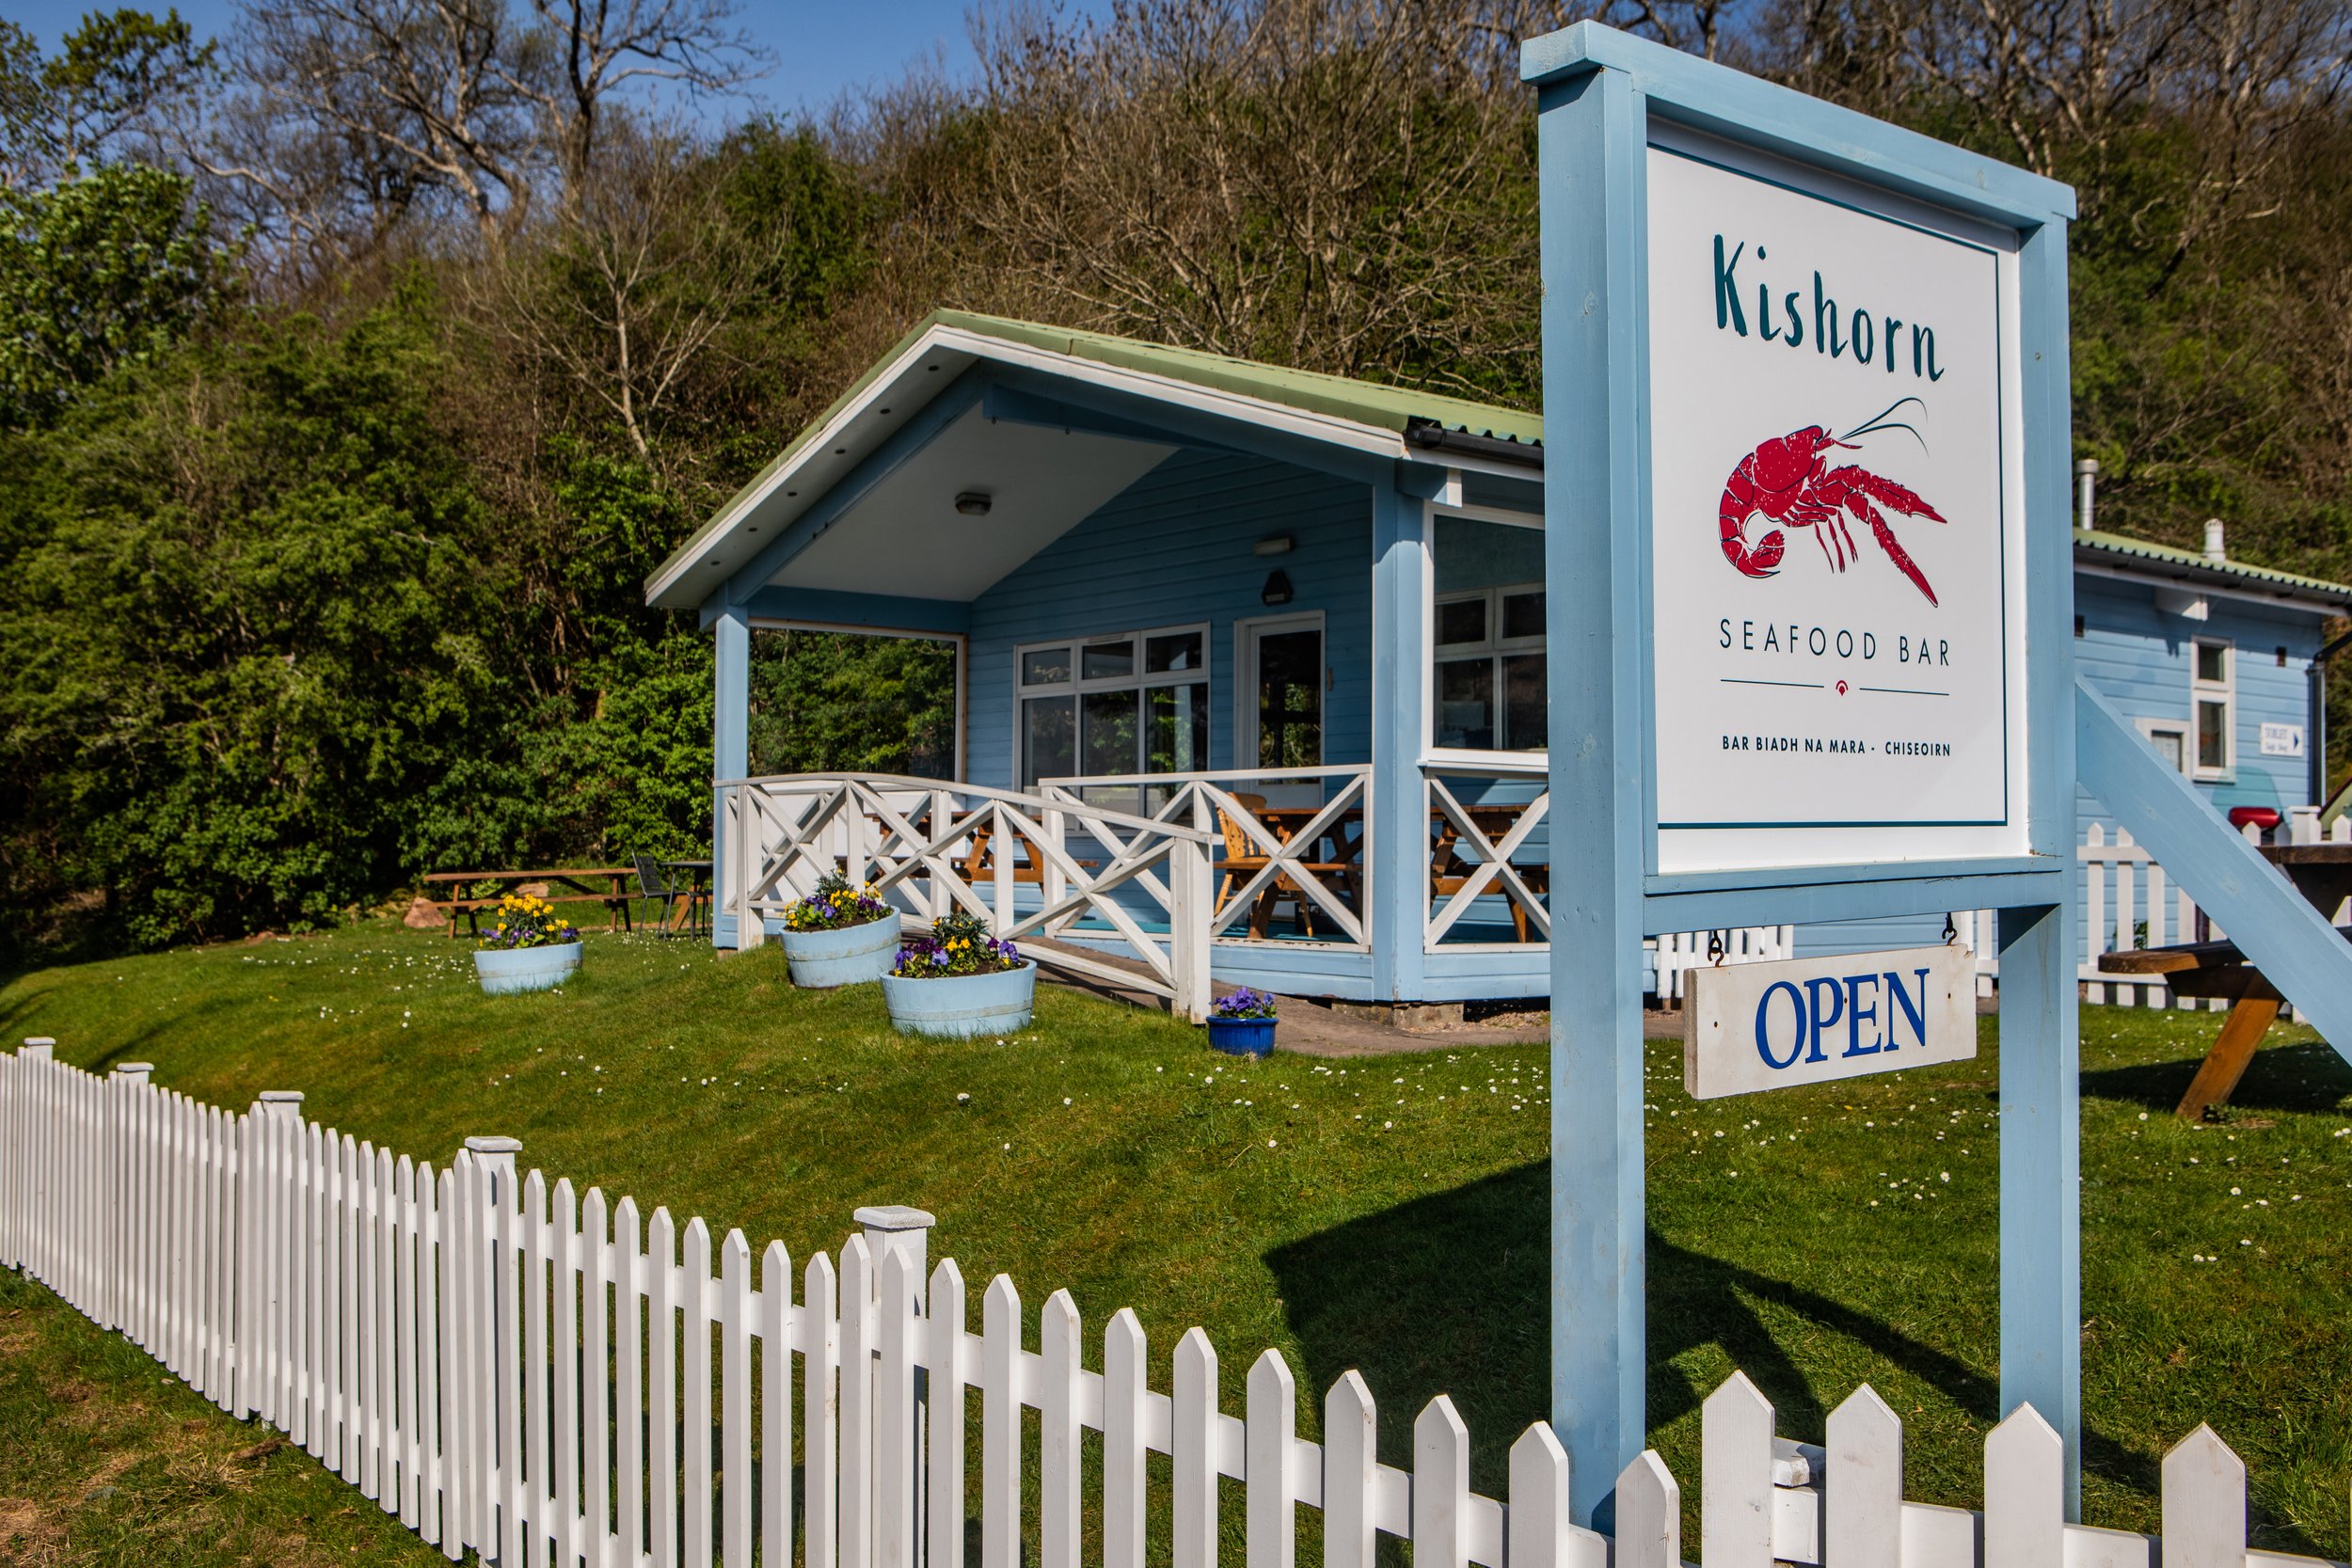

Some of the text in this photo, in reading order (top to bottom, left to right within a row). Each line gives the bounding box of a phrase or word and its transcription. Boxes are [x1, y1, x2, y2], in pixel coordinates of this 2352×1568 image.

[1713, 233, 1945, 383] Kishorn
[1720, 618, 1949, 666] SEAFOOD BAR
[1723, 736, 1749, 751] BAR
[1756, 736, 1798, 752] BIADH
[1804, 738, 1823, 752] NA
[1829, 739, 1866, 753] MARA
[1884, 741, 1950, 756] CHISEOIRN
[1755, 968, 1931, 1069] OPEN
